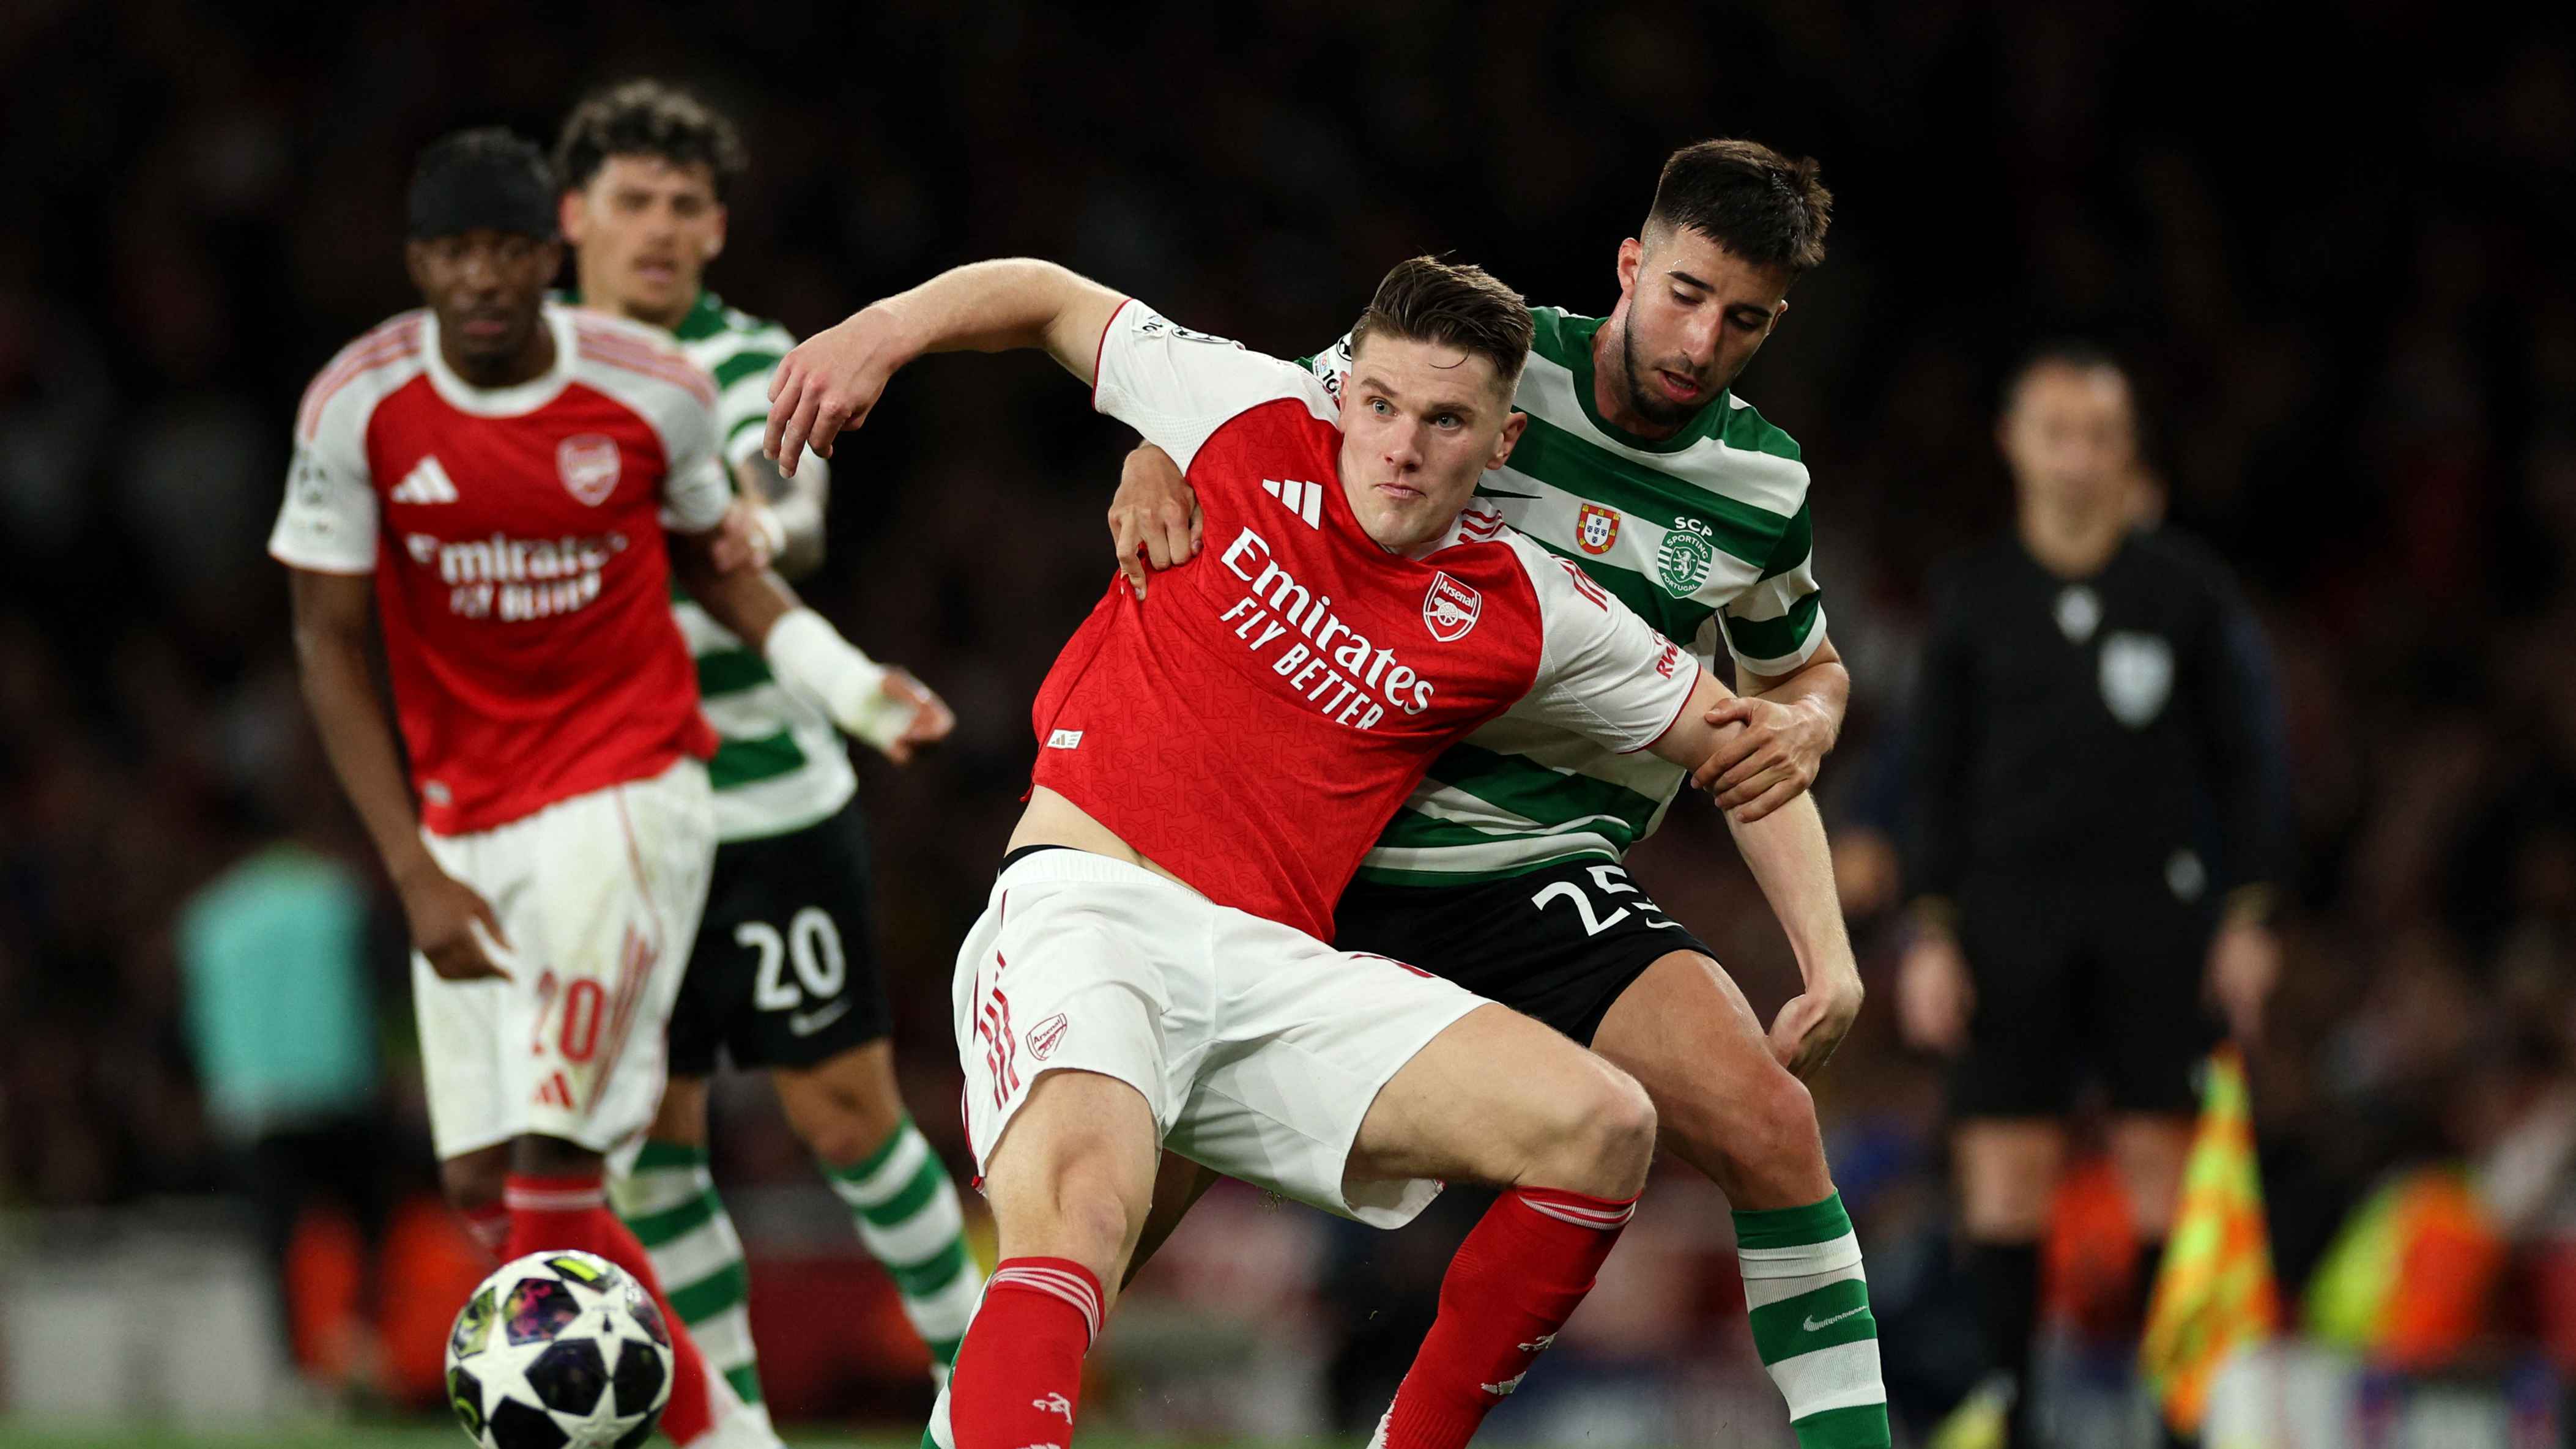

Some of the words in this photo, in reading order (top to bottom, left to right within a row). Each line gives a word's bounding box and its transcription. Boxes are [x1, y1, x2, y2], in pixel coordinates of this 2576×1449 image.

[1674, 517, 1713, 536] SCP
[1666, 535, 1709, 559] SPORTING
[1439, 581, 1475, 608] Arsenal
[1661, 572, 1698, 591] PORTUGAL
[1220, 526, 1435, 715] Emirates
[1220, 596, 1287, 651] FLY
[1272, 642, 1384, 730] BETTER
[1531, 865, 1662, 936] 25
[736, 905, 845, 1011] 20
[1034, 1019, 1060, 1044] Arsenal
